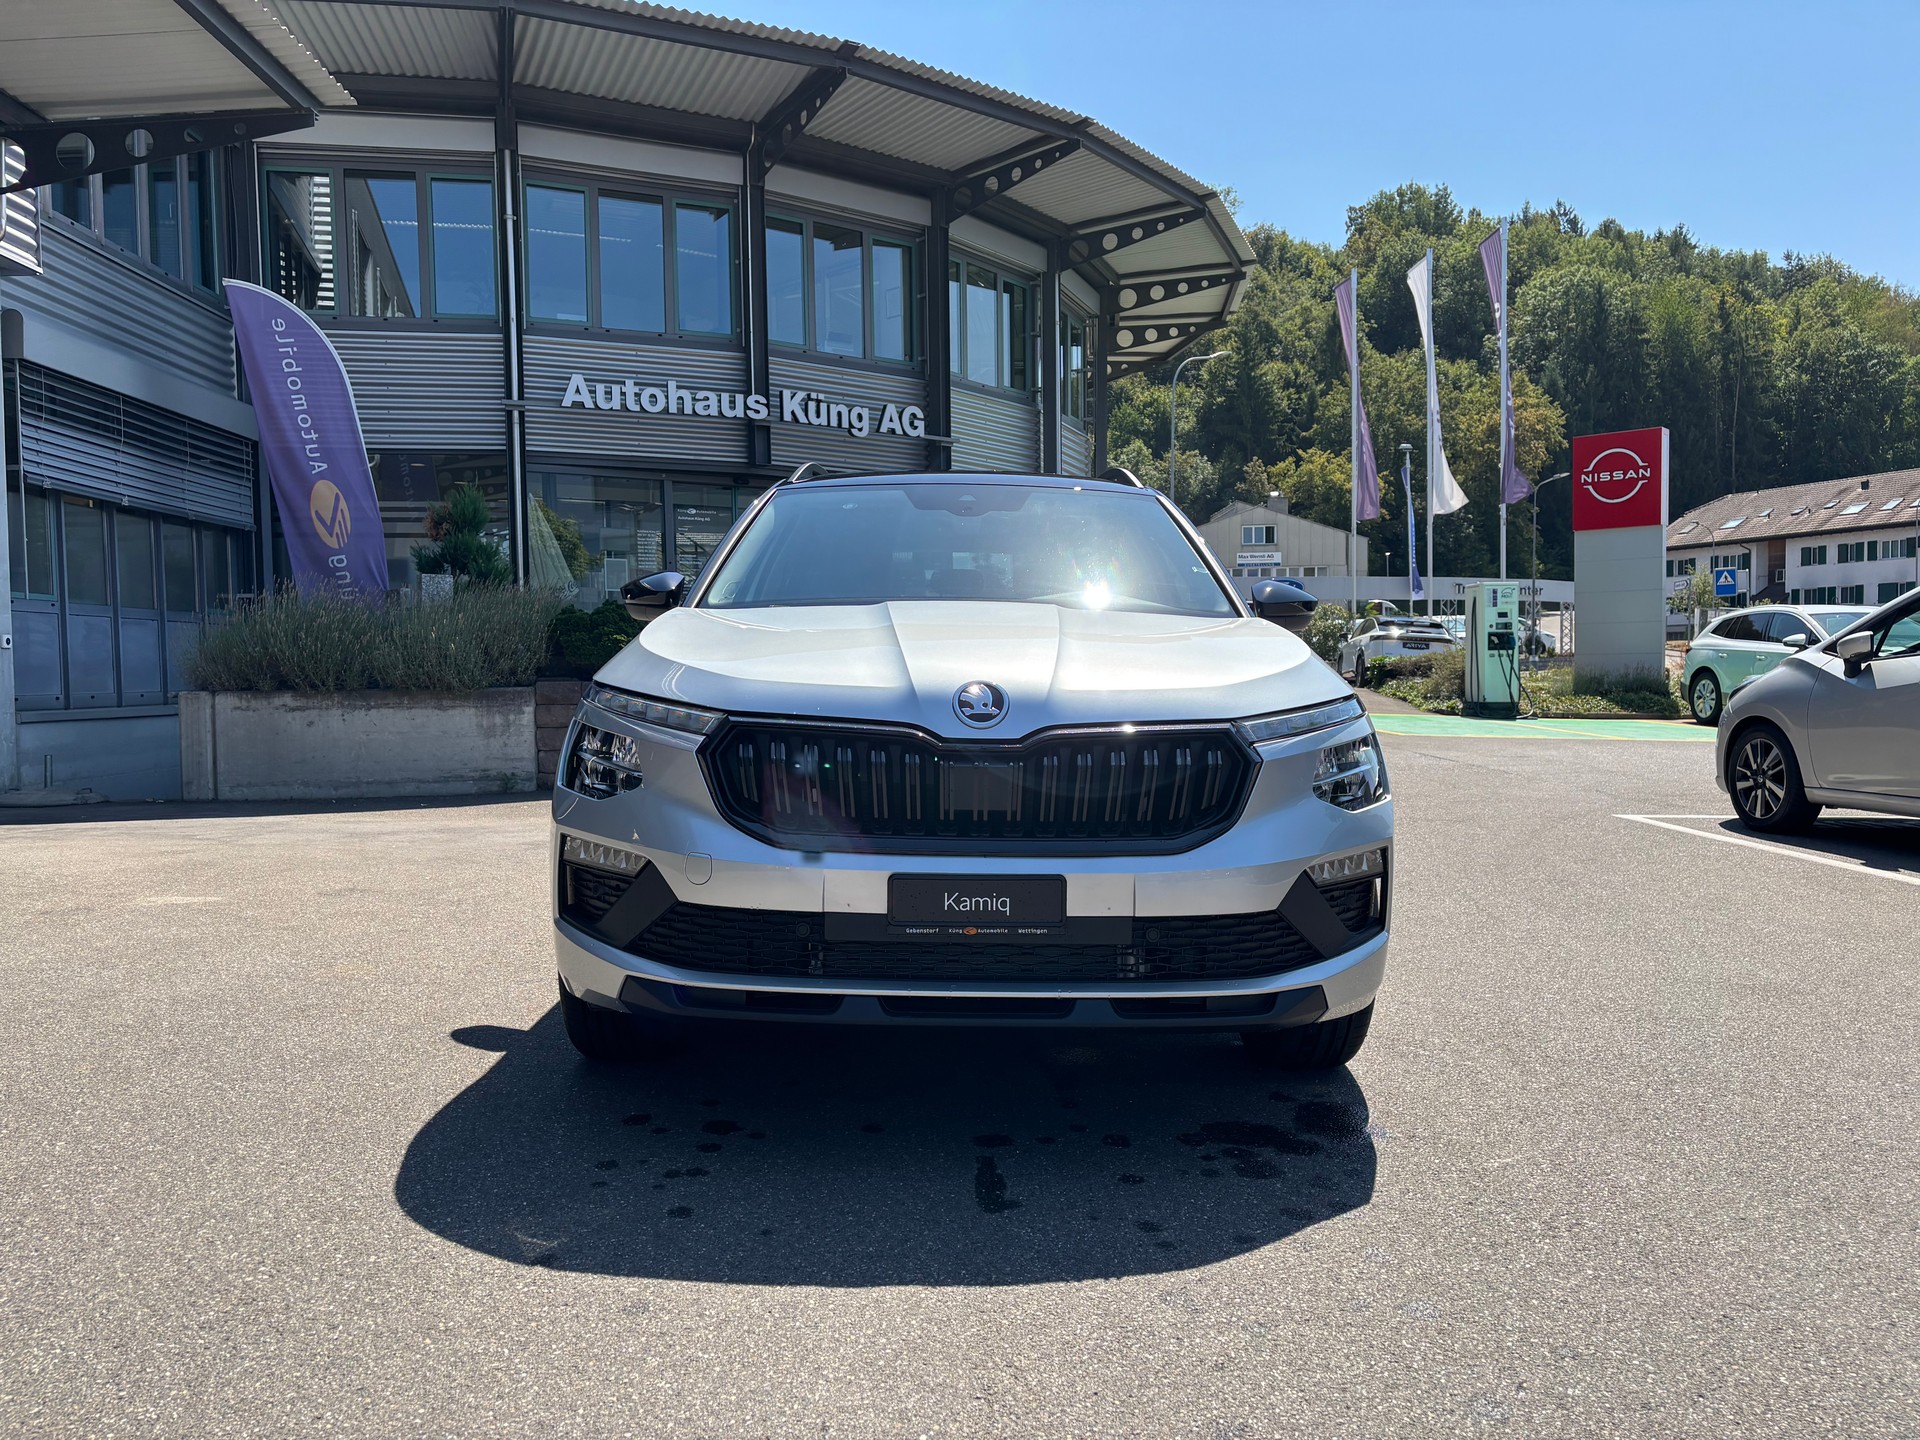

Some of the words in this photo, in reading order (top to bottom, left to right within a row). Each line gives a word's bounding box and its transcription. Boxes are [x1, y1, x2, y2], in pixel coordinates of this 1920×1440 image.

[560, 373, 770, 420] Autohaus
[780, 389, 870, 438] Küng
[878, 403, 926, 438] AG
[1581, 467, 1651, 484] NISSAN
[944, 892, 1010, 916] Kamiq
